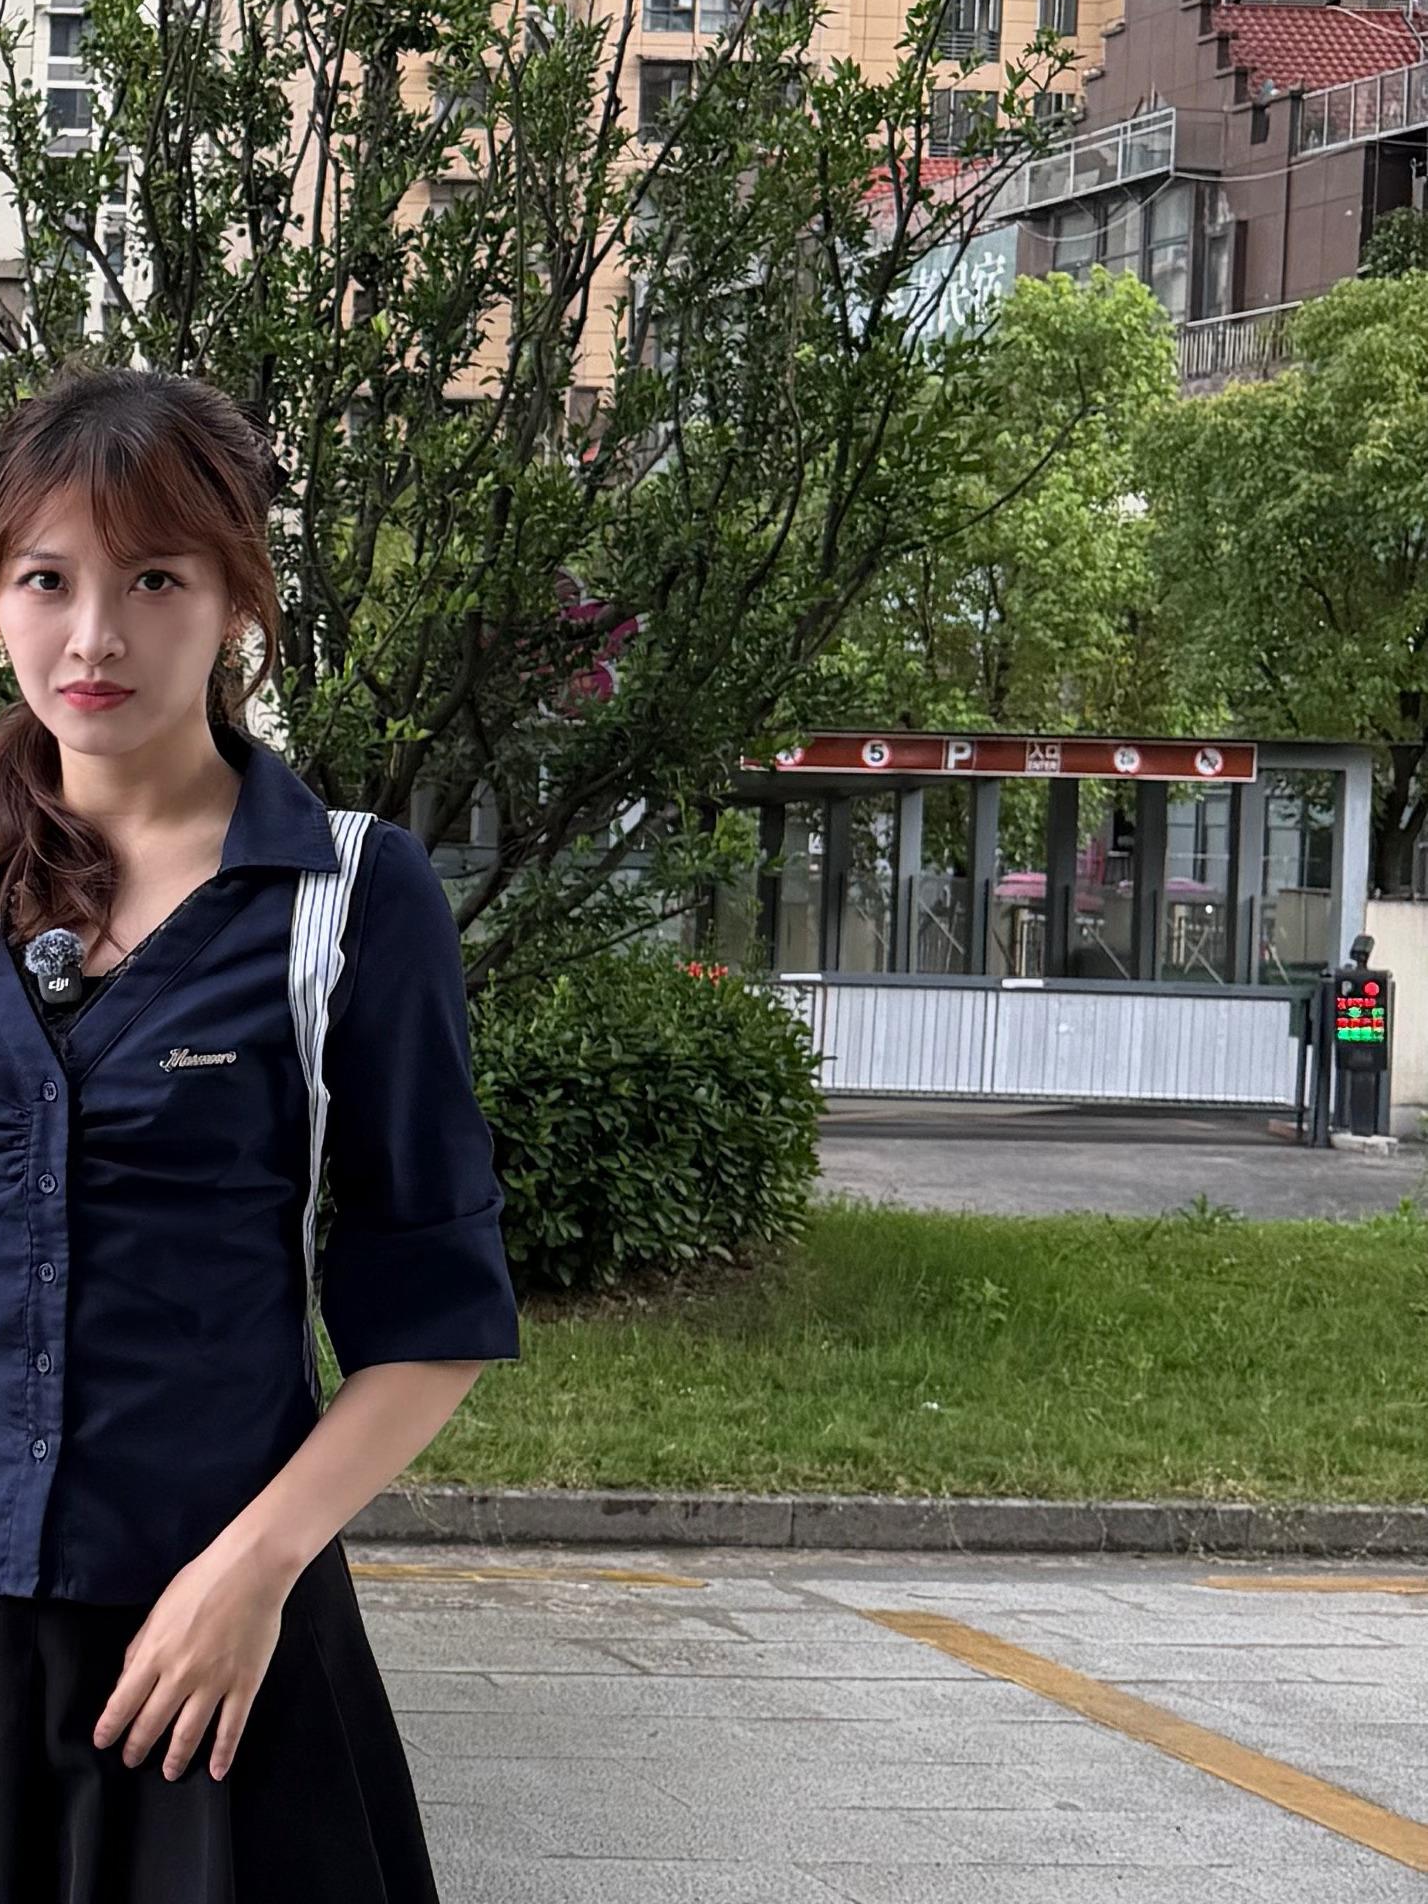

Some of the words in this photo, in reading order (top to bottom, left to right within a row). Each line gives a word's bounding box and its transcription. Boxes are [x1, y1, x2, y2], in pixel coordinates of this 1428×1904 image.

[869, 744, 885, 763] 5
[947, 741, 972, 769] P
[1028, 743, 1058, 759] 入口
